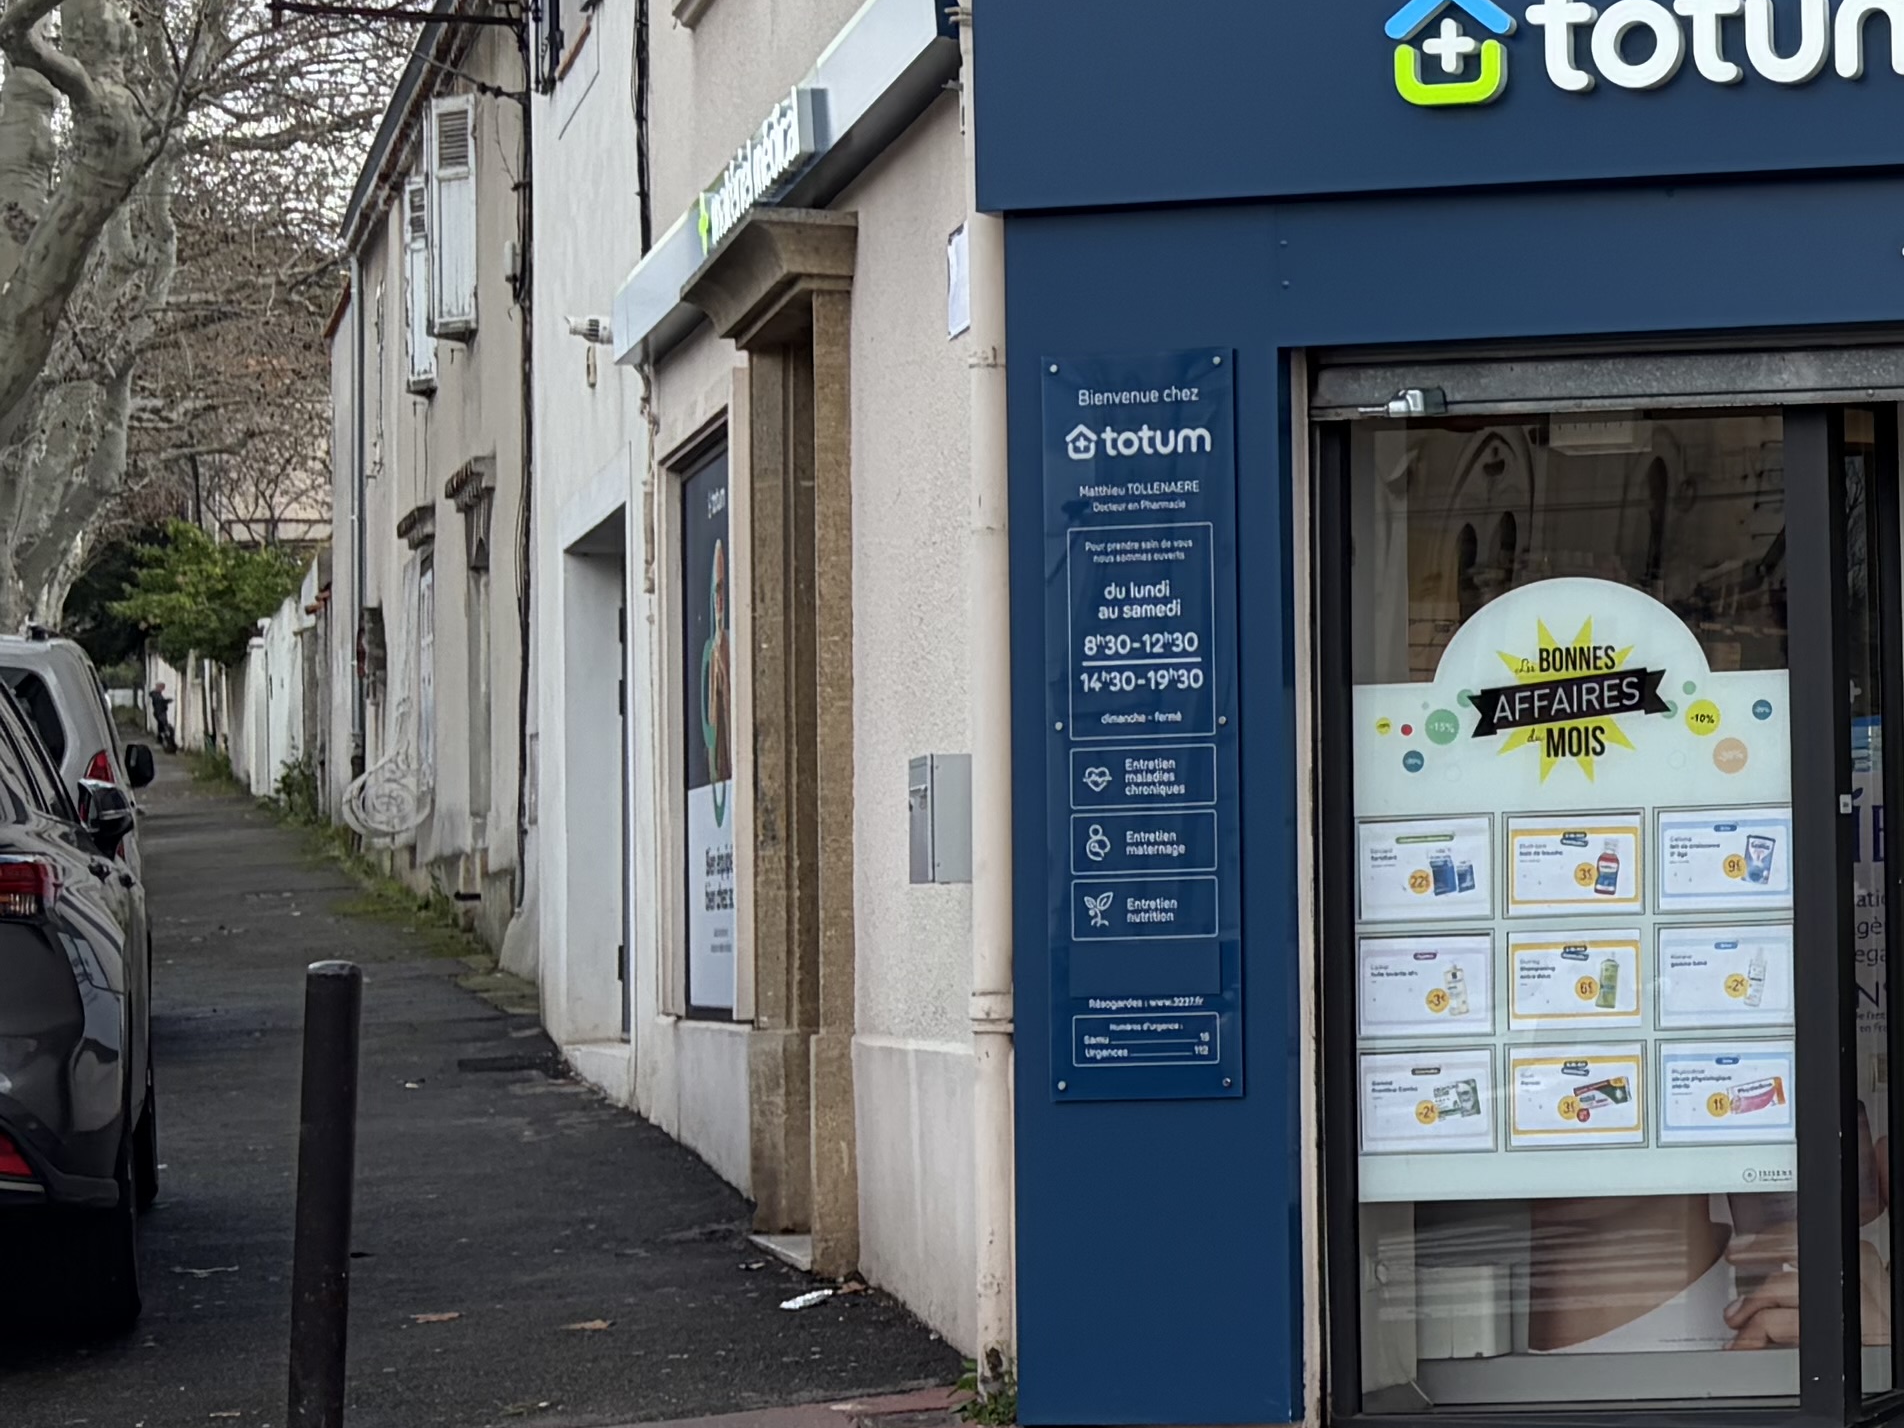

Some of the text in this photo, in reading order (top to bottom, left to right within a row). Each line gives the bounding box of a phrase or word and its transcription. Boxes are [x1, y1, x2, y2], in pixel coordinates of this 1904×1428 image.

[1078, 386, 1199, 406] Bienvenue chez
[1101, 424, 1212, 456] totum
[1079, 480, 1199, 497] Matthieu TOLLENAERE
[1093, 502, 1126, 512] Docteur
[1141, 499, 1186, 510] Pharmacie
[1104, 579, 1170, 600] du lundi
[1098, 599, 1181, 619] au samedi
[1538, 645, 1616, 673] BONNES
[1493, 677, 1640, 723] AFFAIRES
[1101, 711, 1182, 724] dimanche fermé
[1690, 713, 1715, 724] -10%
[1546, 725, 1606, 758] MOIS
[1125, 758, 1176, 771] Entretien
[1125, 771, 1175, 783] maladies
[1125, 783, 1185, 797] chroniques
[1126, 830, 1176, 843] Entretien
[1126, 843, 1186, 857] maternage
[1127, 897, 1177, 910] Entretien
[1127, 910, 1174, 922] nutrition
